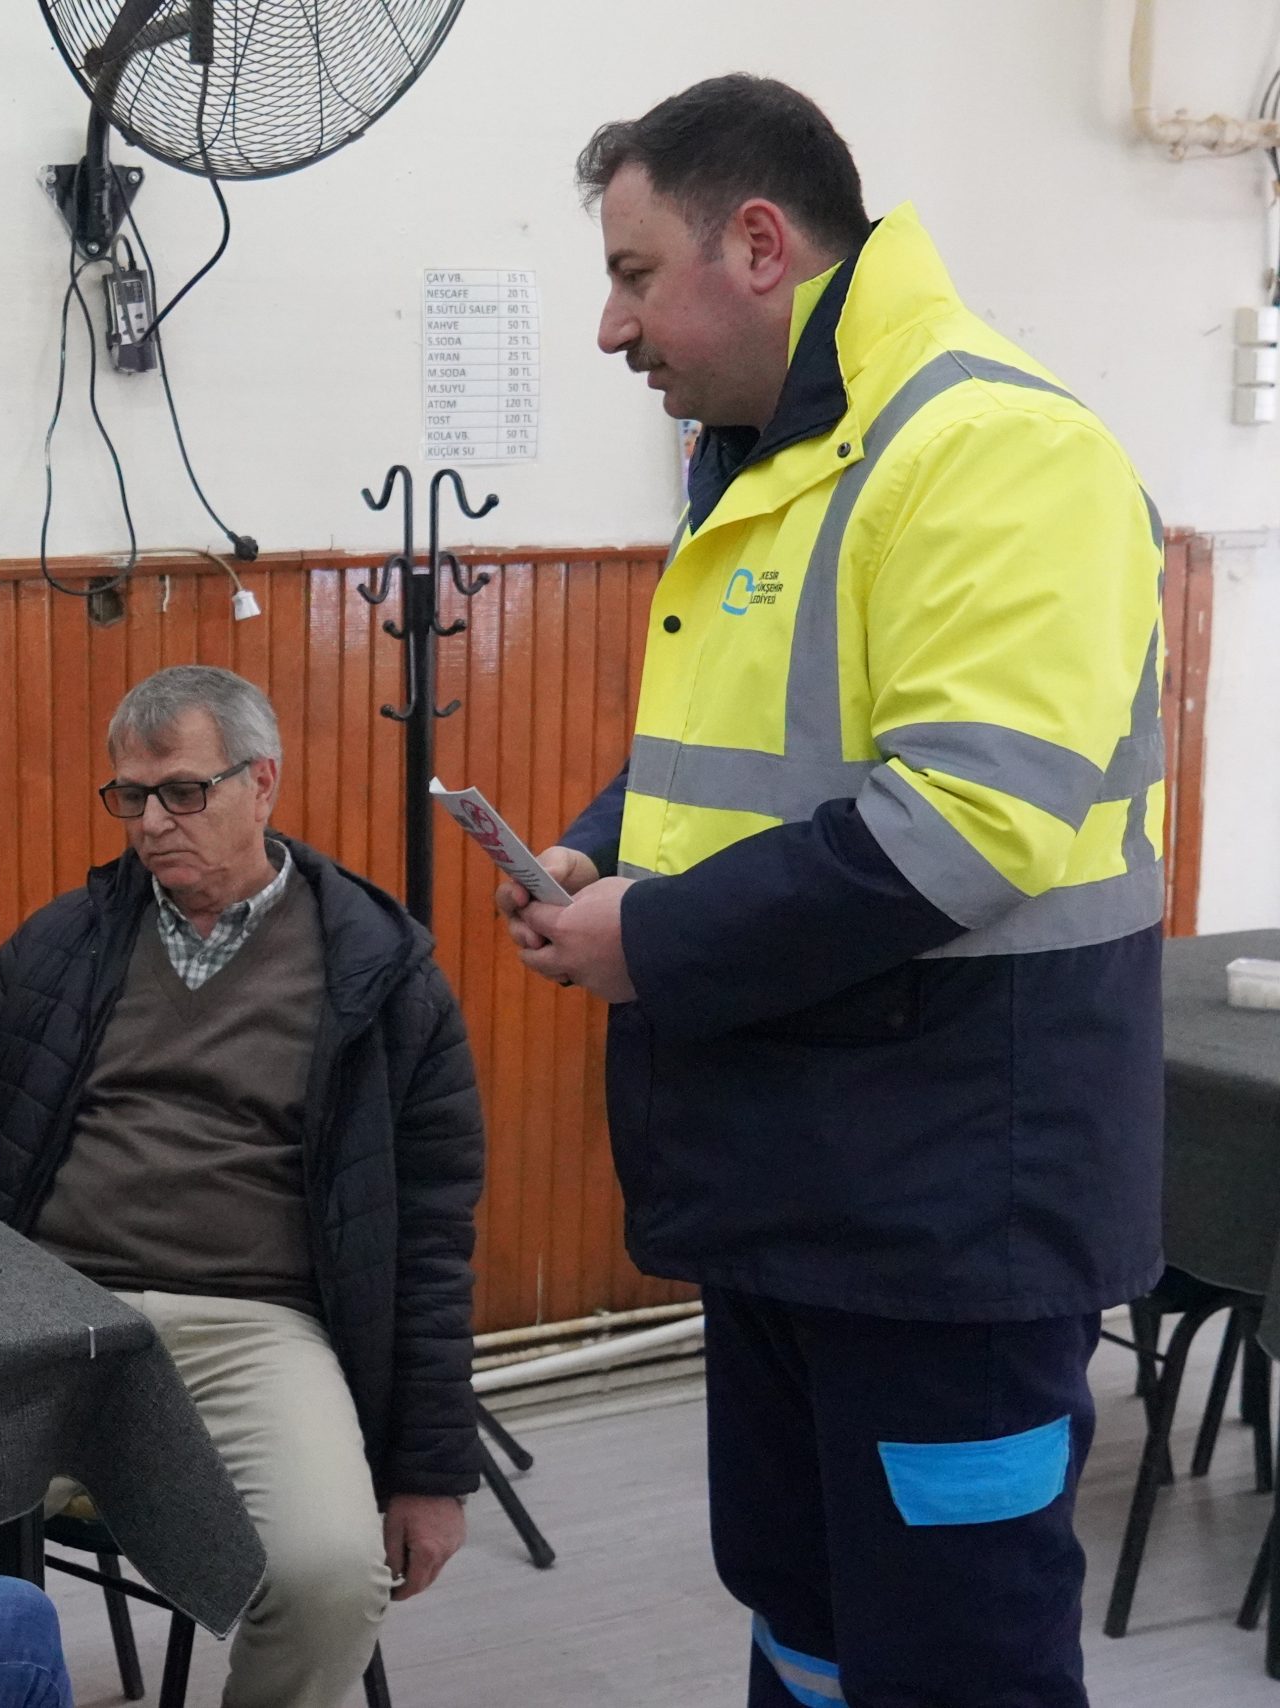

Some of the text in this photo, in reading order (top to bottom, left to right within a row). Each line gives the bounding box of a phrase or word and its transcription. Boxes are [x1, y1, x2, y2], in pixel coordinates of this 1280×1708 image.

[426, 273, 528, 284] ÇAY VB. 15 TL
[426, 289, 529, 299] NESCAFE 20 TL
[427, 303, 466, 315] B.SÜTLÜ
[468, 304, 497, 315] SALEP
[521, 305, 530, 314] TL
[427, 320, 530, 330] KAHVE 50 TL
[427, 336, 531, 346] S.SODA 25 TL
[427, 351, 531, 362] AYRAN 25 TL
[427, 367, 532, 378] M.SODA 30 TL
[427, 383, 531, 394] M.SUYU 50 TL
[427, 399, 533, 409] ATOM 120 TL
[427, 414, 532, 425] TOST 120 TL
[427, 431, 451, 441] KOLA
[506, 429, 518, 439] 50
[520, 429, 529, 439] TL
[427, 445, 528, 458] KÜÇÜK SU 10 TL
